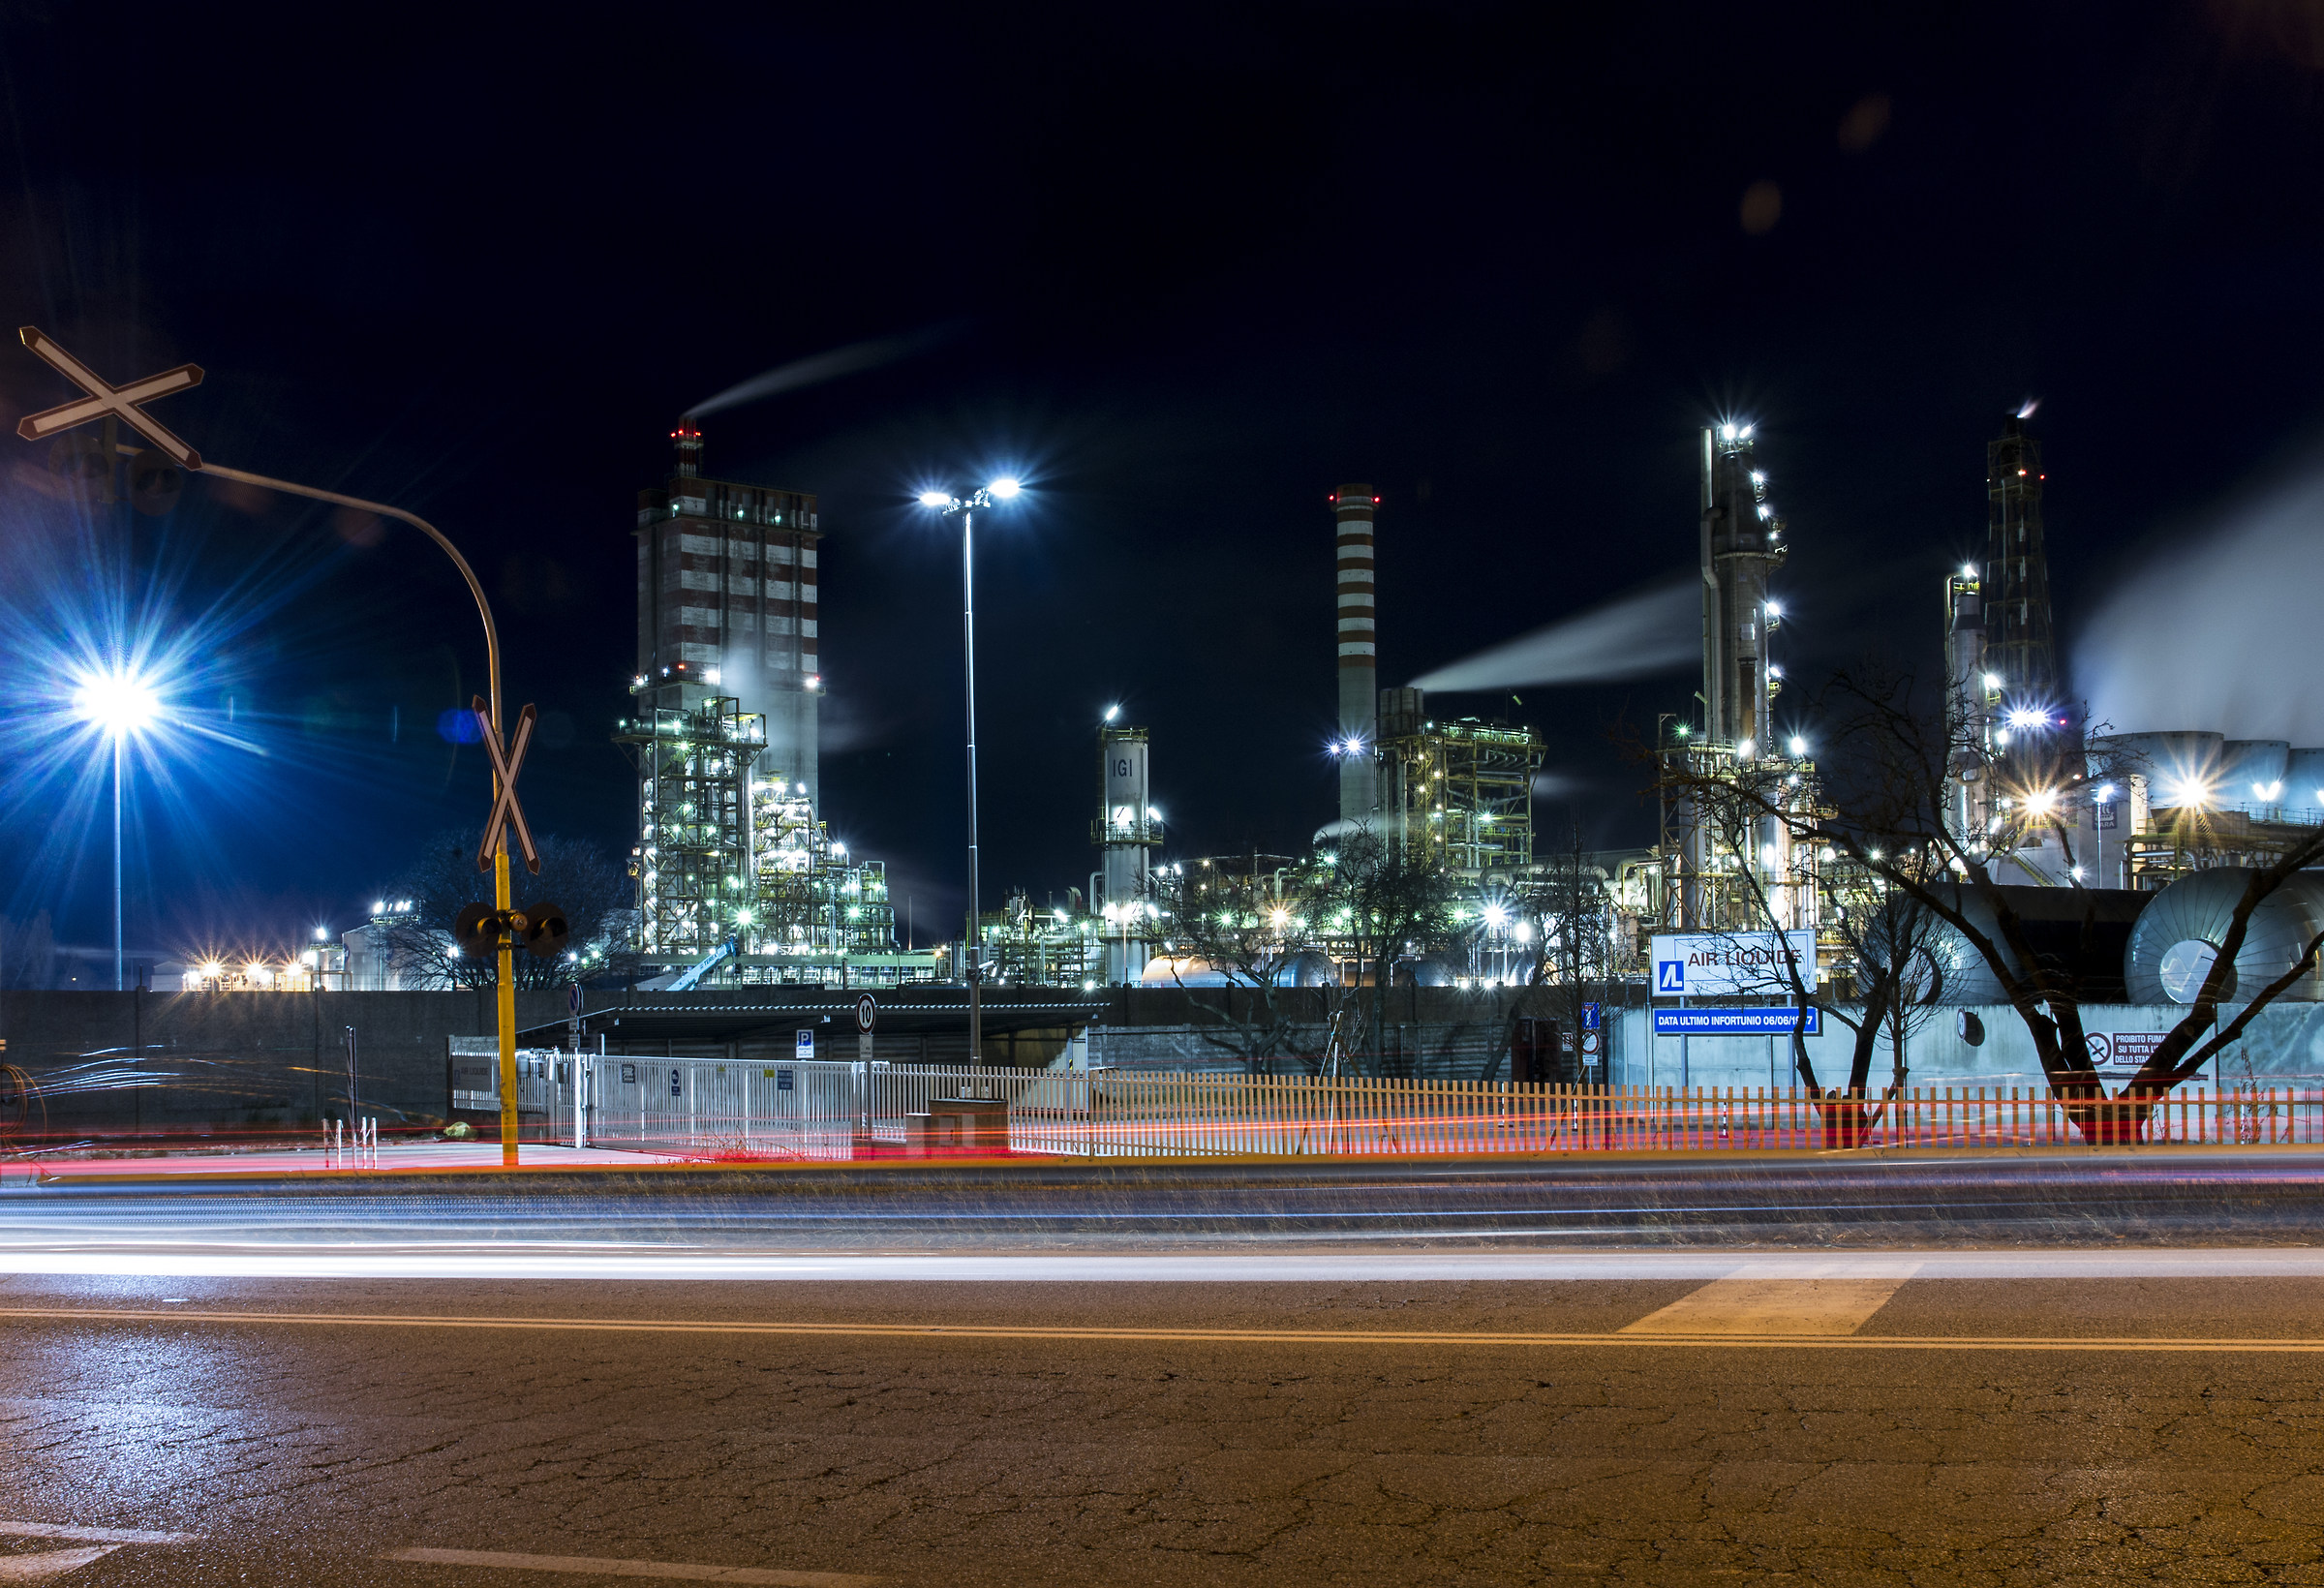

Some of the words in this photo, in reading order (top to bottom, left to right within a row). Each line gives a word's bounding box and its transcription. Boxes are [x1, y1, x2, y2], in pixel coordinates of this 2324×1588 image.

[1688, 952, 1719, 966] AIR
[1725, 949, 1802, 966] LIQUDE
[862, 1005, 872, 1023] 10
[1658, 1016, 1678, 1026] DATA
[1680, 1016, 1710, 1026] ULTIMO
[1711, 1015, 1761, 1026] INFORTUNIO
[801, 1032, 810, 1046] P
[2116, 1034, 2146, 1044] PROIBITO
[2118, 1045, 2127, 1054] SU
[2115, 1054, 2133, 1064] DELLO
